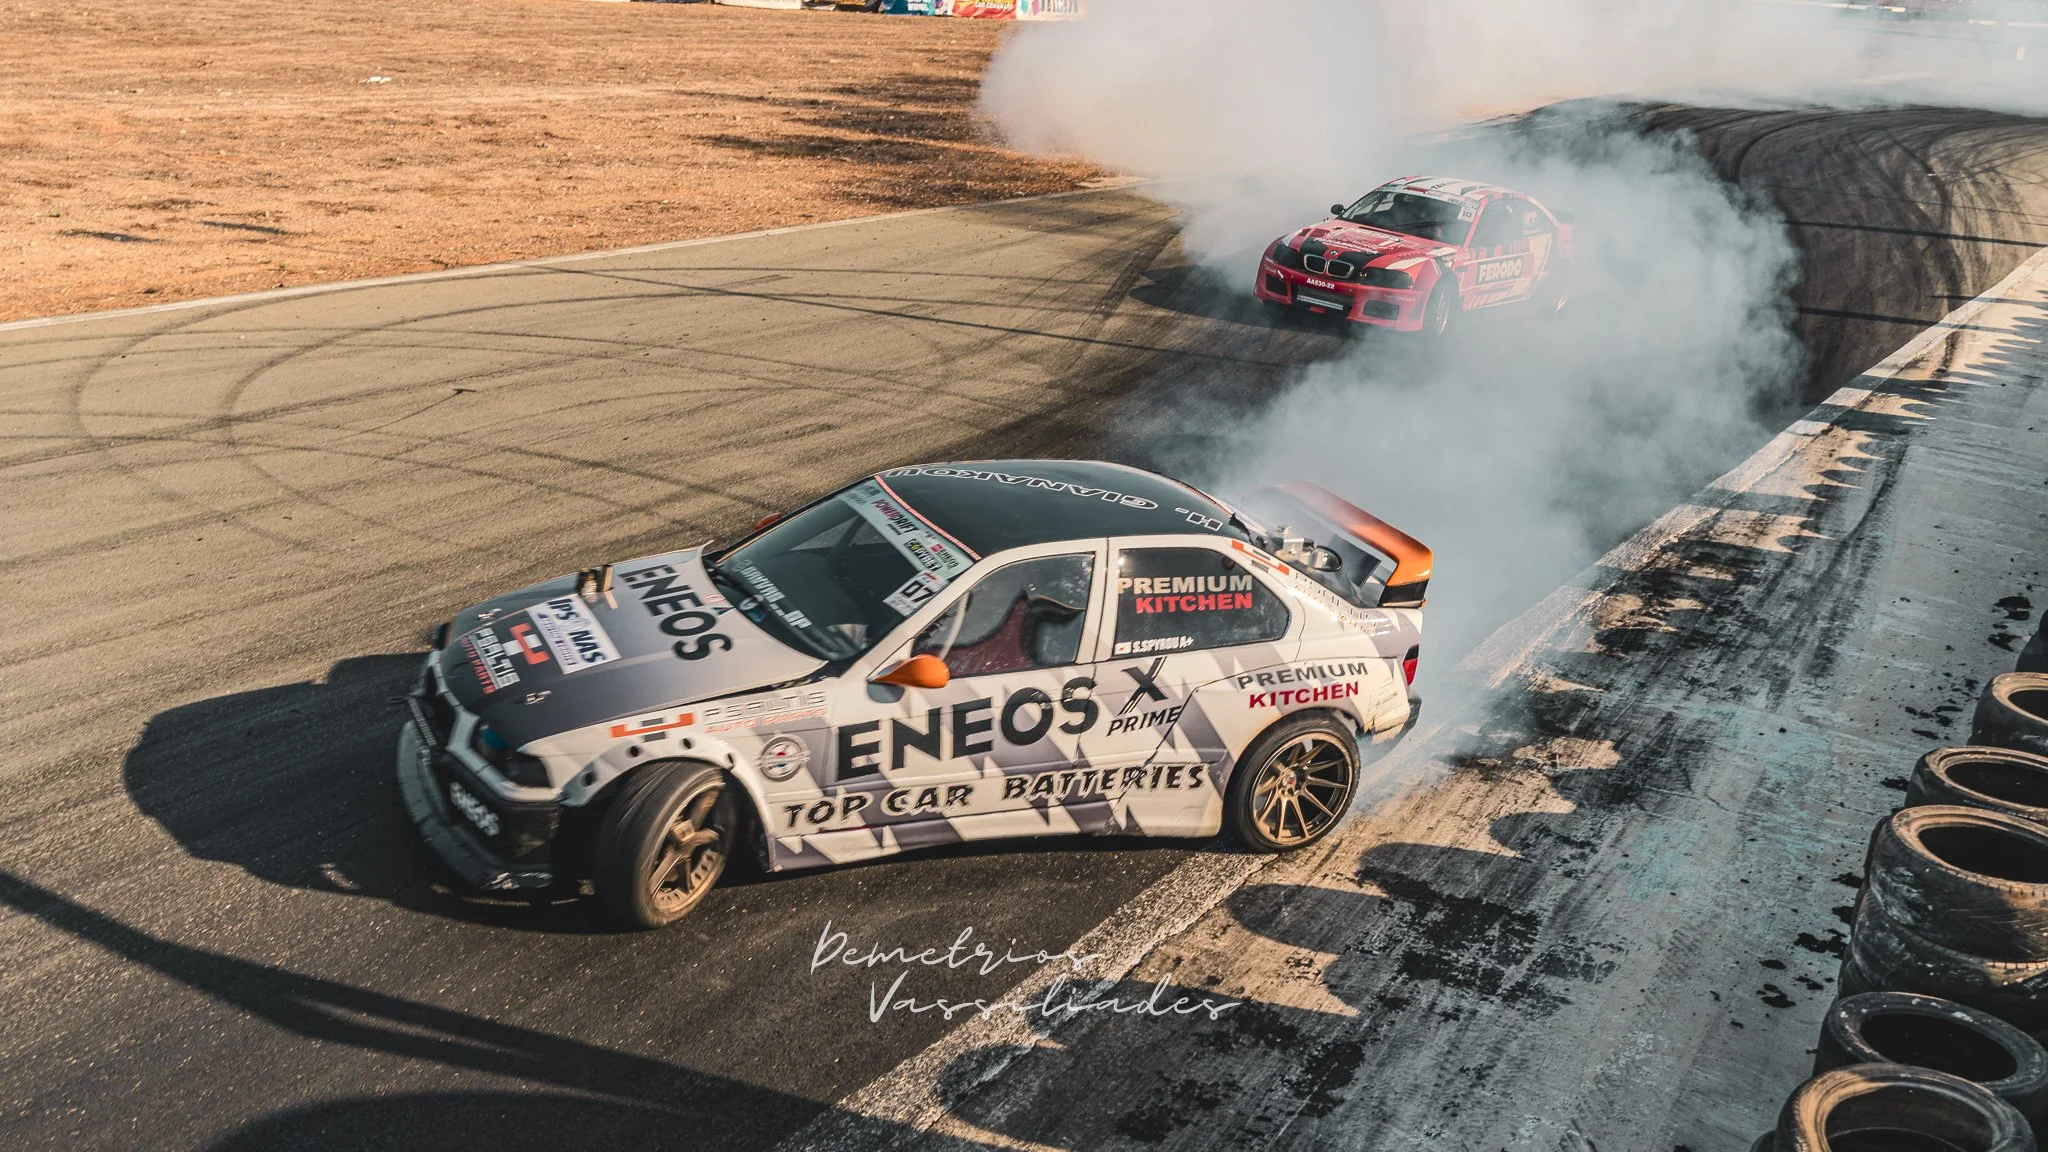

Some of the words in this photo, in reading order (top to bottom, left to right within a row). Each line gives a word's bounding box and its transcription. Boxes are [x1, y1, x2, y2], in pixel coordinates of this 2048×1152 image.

[1478, 259, 1522, 283] FERODO
[900, 580, 937, 603] 07
[1118, 574, 1253, 595] PREMIUM
[618, 564, 734, 661] ENEOS
[1136, 593, 1253, 614] KITCHEN
[1119, 656, 1169, 715] X
[1237, 662, 1368, 690] PREMIUM
[1249, 682, 1359, 709] KITCHEN
[836, 677, 1099, 781] ENEOS
[1106, 705, 1182, 736] PRIME
[783, 791, 871, 830] TOP
[880, 784, 976, 816] CAR
[1001, 762, 1210, 801] BATTERIES
